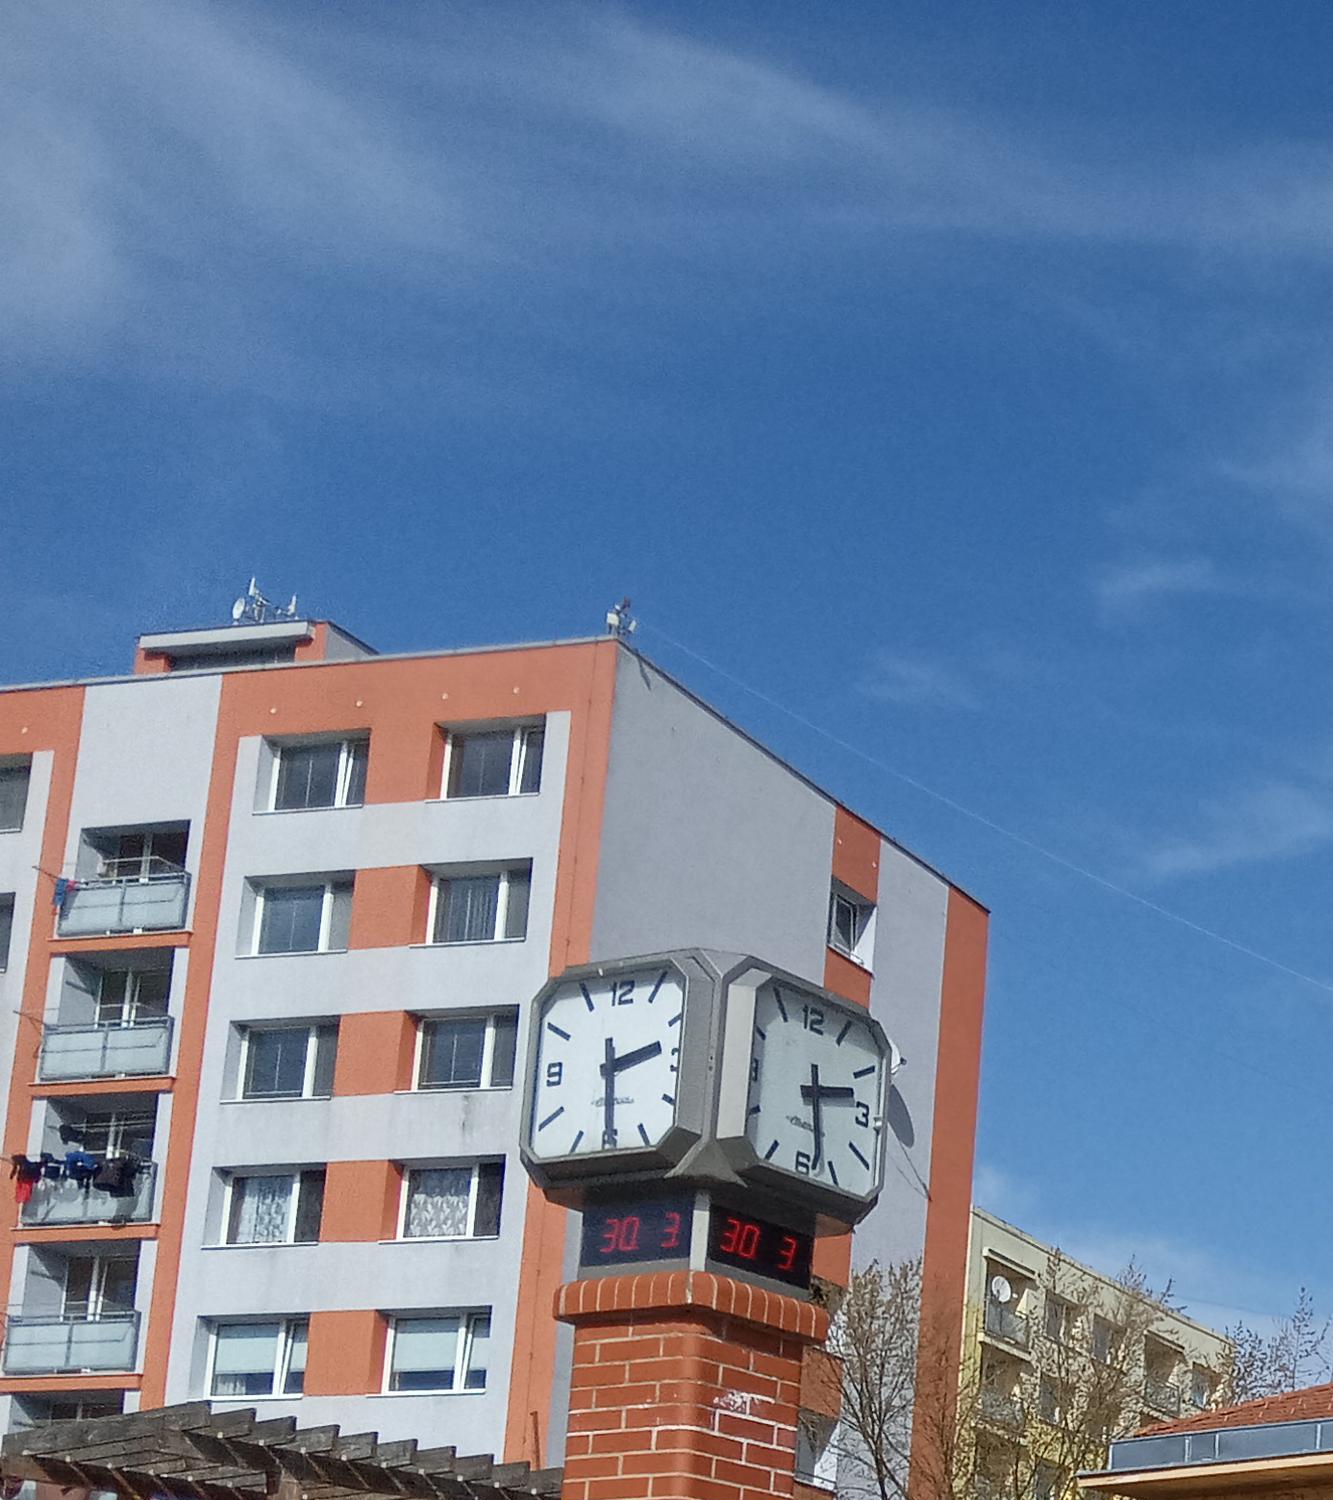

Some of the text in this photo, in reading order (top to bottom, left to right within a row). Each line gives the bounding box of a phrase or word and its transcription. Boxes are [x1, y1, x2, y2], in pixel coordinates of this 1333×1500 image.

[611, 980, 635, 1006] 12
[802, 1004, 825, 1035] 12
[546, 1061, 563, 1086] 9
[855, 1101, 870, 1128] 3
[795, 1150, 811, 1176] 6
[661, 1211, 681, 1248] 3
[776, 1236, 797, 1270] 3
